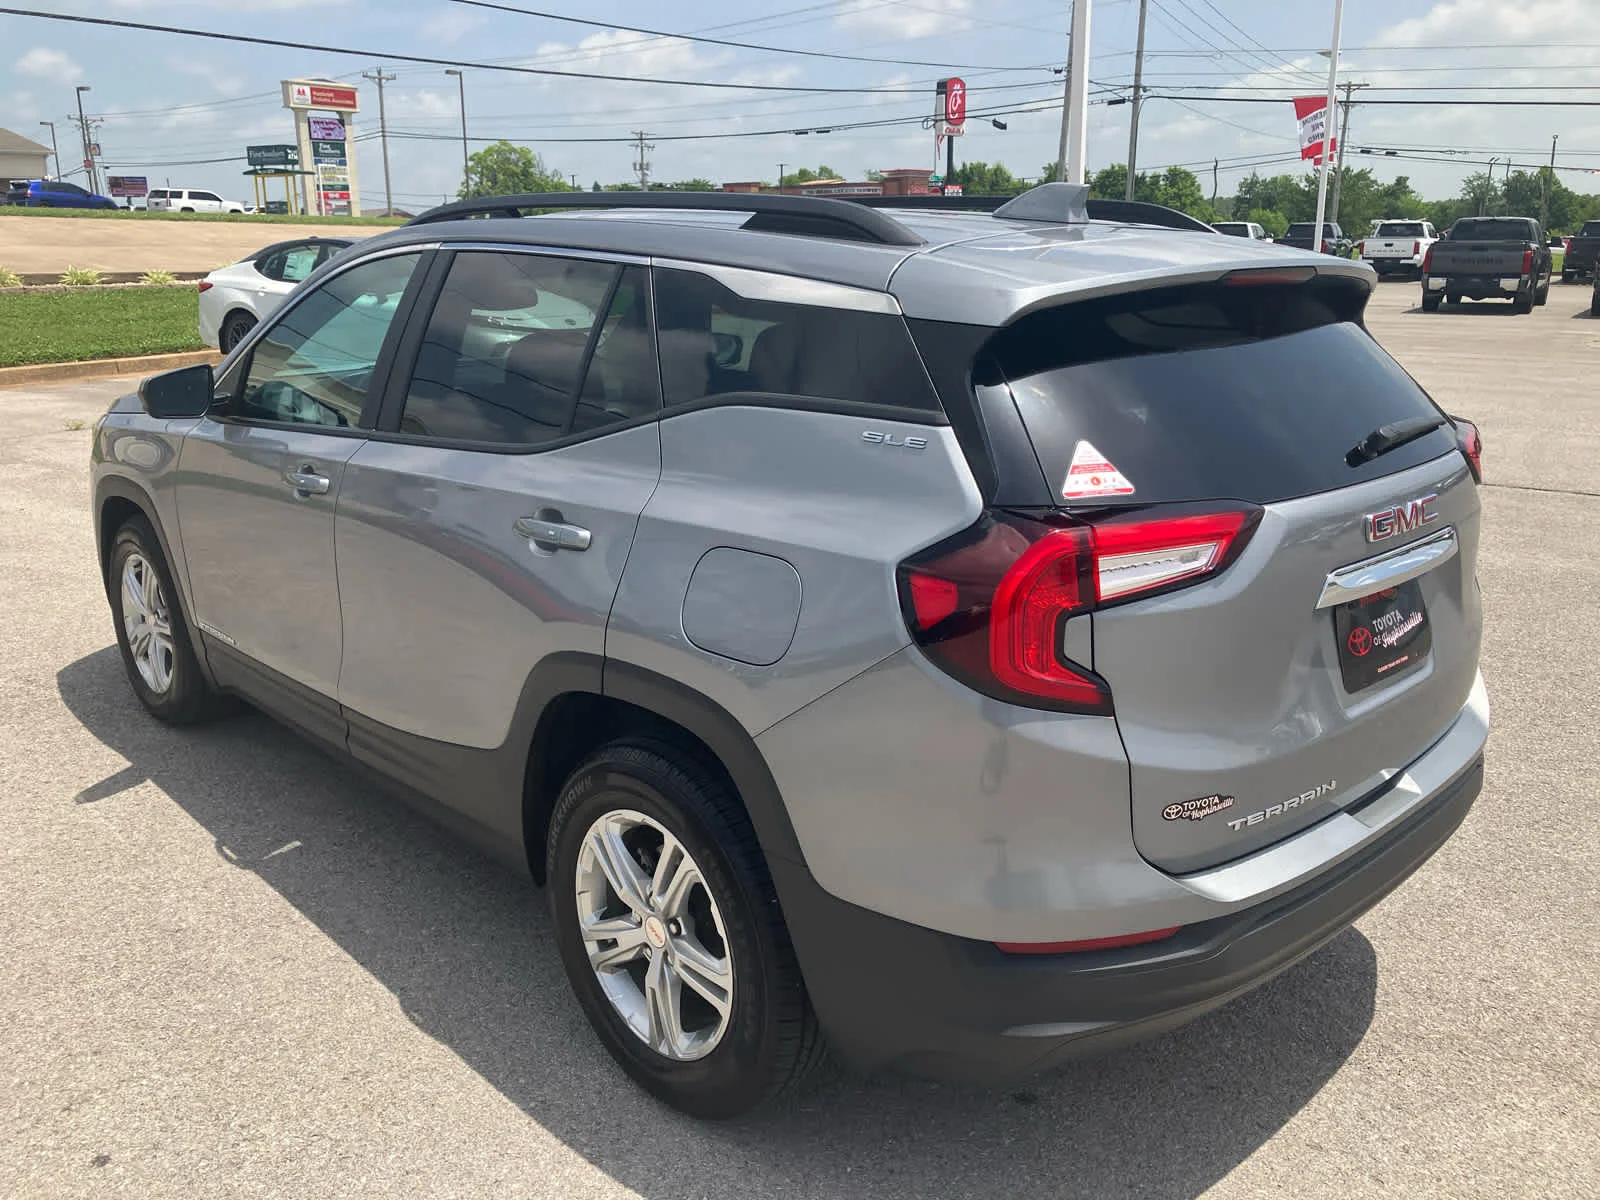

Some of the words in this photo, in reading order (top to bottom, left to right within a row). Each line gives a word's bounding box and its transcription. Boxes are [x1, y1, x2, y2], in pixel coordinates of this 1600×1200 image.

[862, 431, 928, 450] SLE
[1364, 494, 1439, 542] GMC
[1372, 609, 1404, 633] TOYOTA
[1382, 611, 1423, 648] Hopkinsville
[1183, 795, 1220, 811] TOYOTA
[1191, 797, 1234, 820] Hopkinsville
[1227, 779, 1337, 832] TERRAIN
